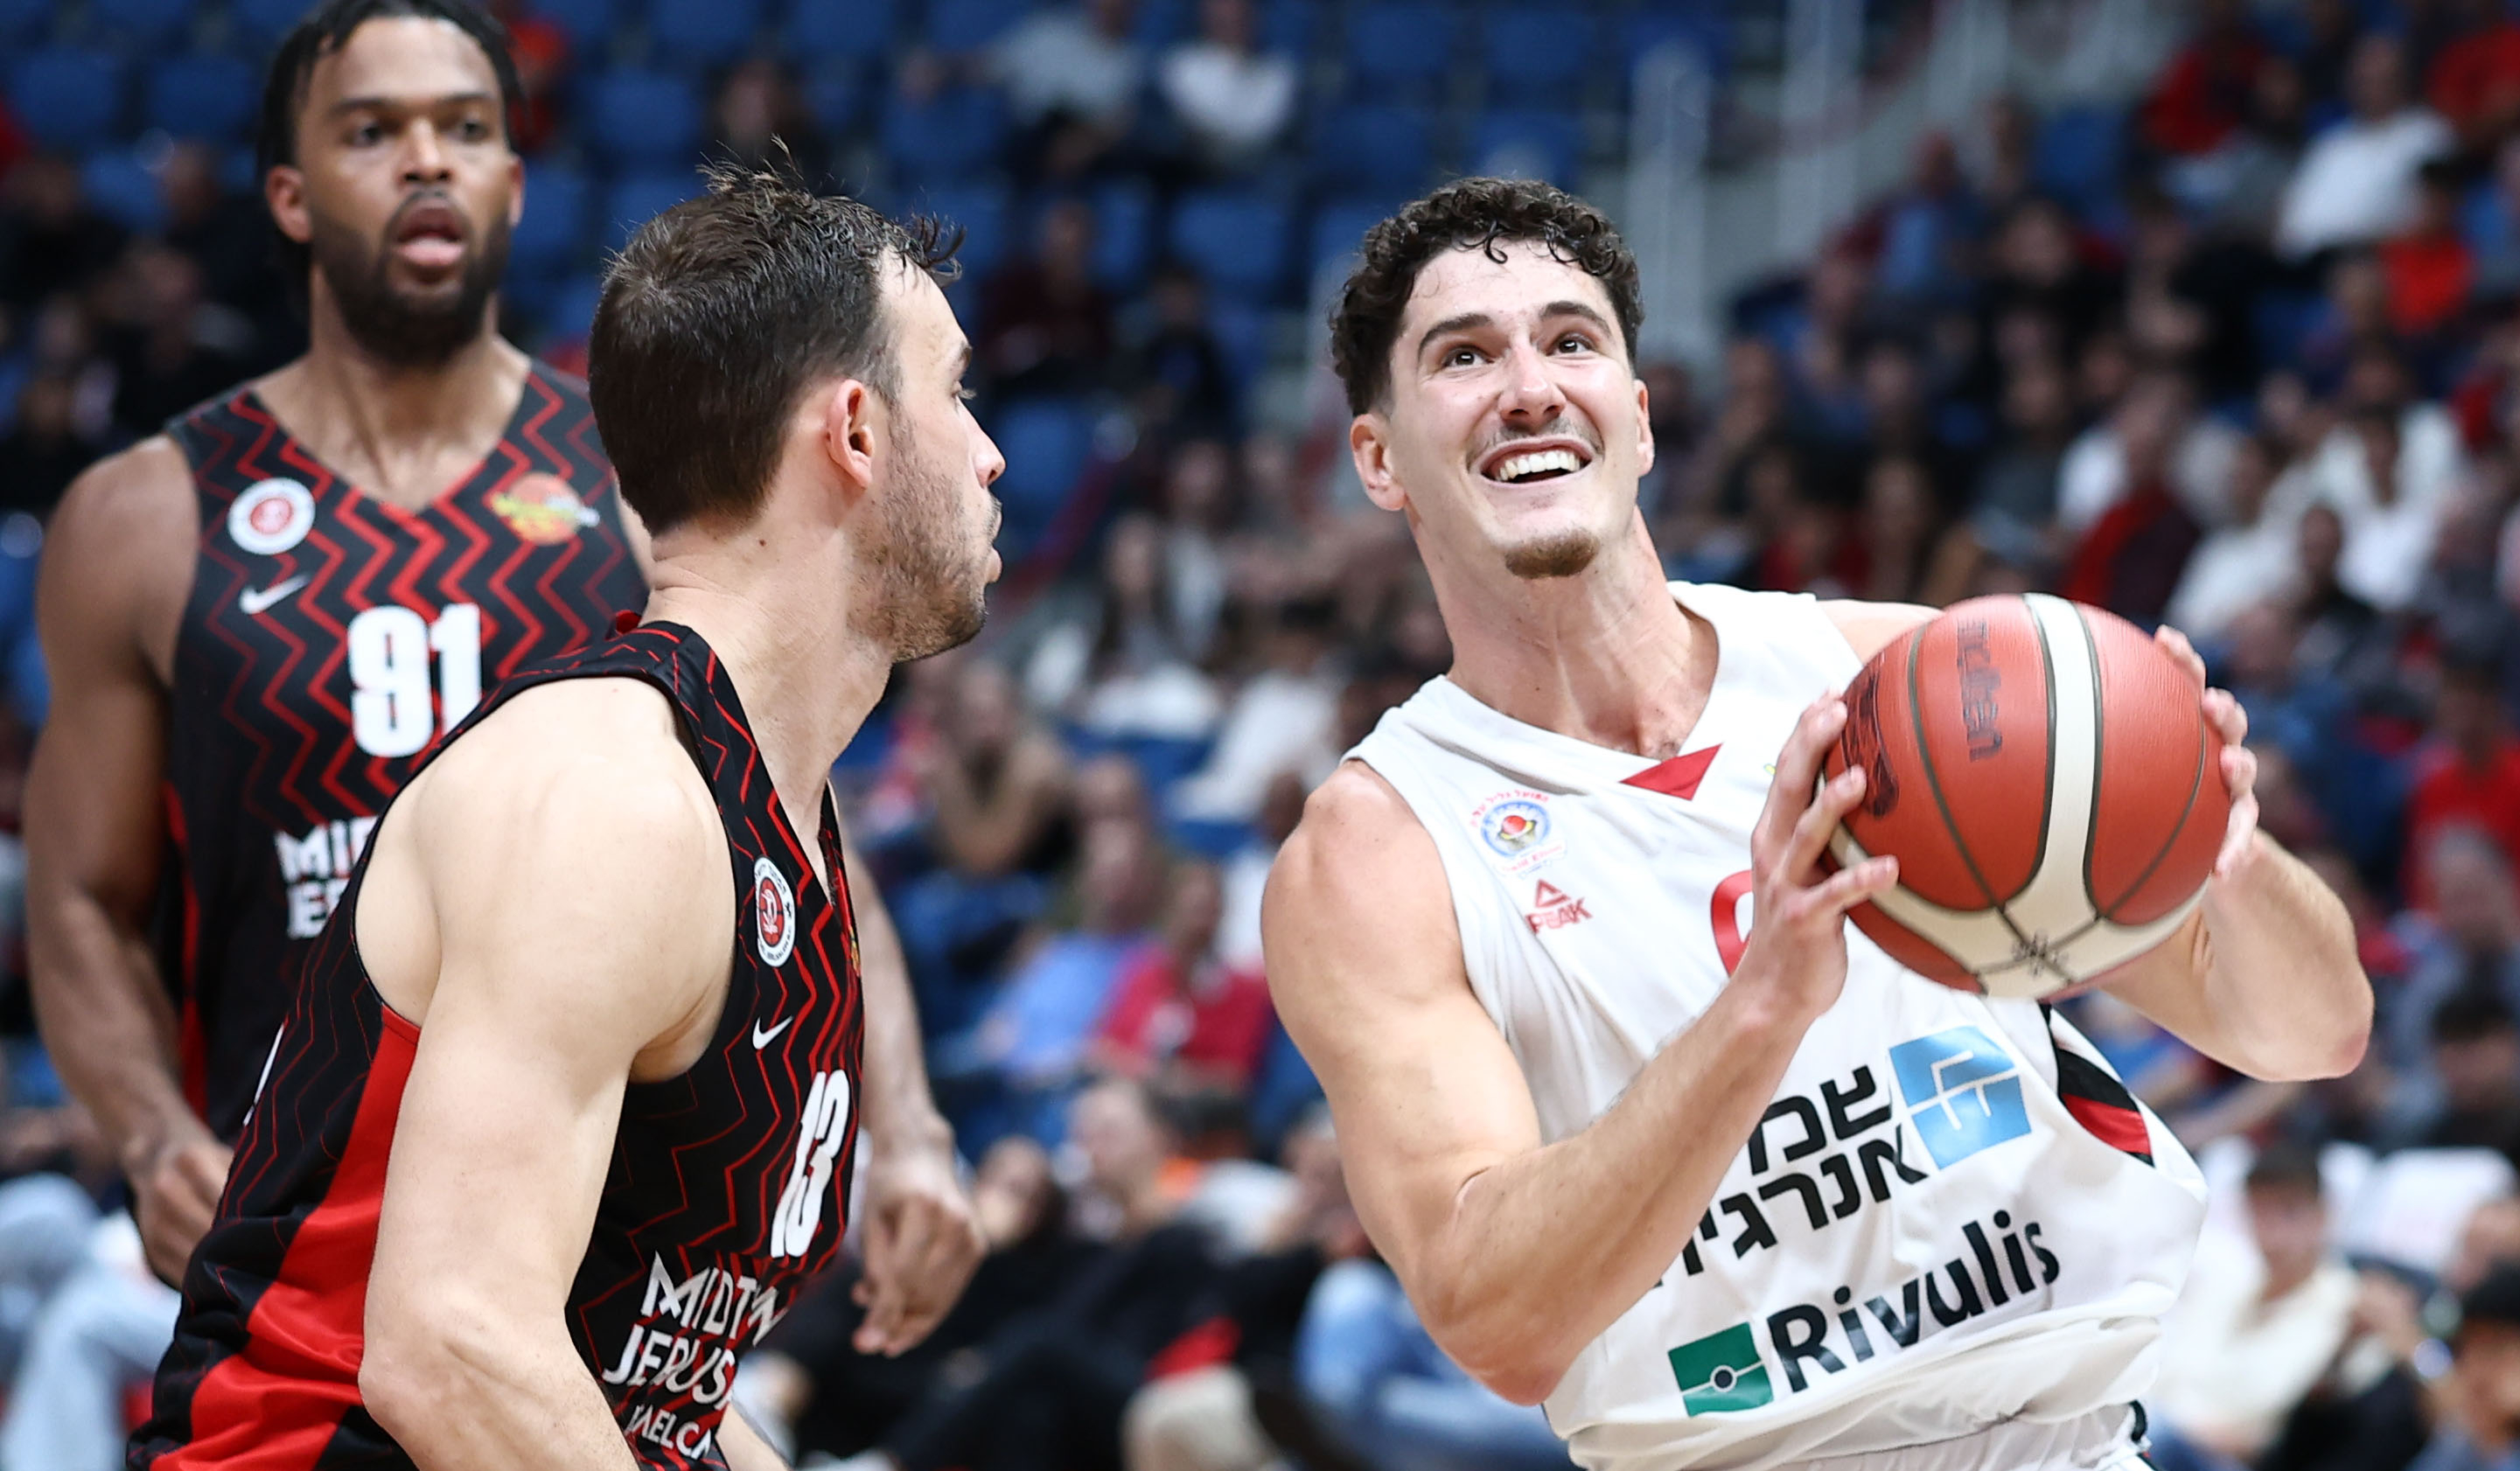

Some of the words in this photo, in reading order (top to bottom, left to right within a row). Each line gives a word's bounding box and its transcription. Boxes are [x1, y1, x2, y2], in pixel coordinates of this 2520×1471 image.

[348, 602, 481, 758] 91
[1525, 896, 1594, 935] PEAK
[771, 1069, 850, 1258] 13
[1767, 1209, 2061, 1393] Rivulis
